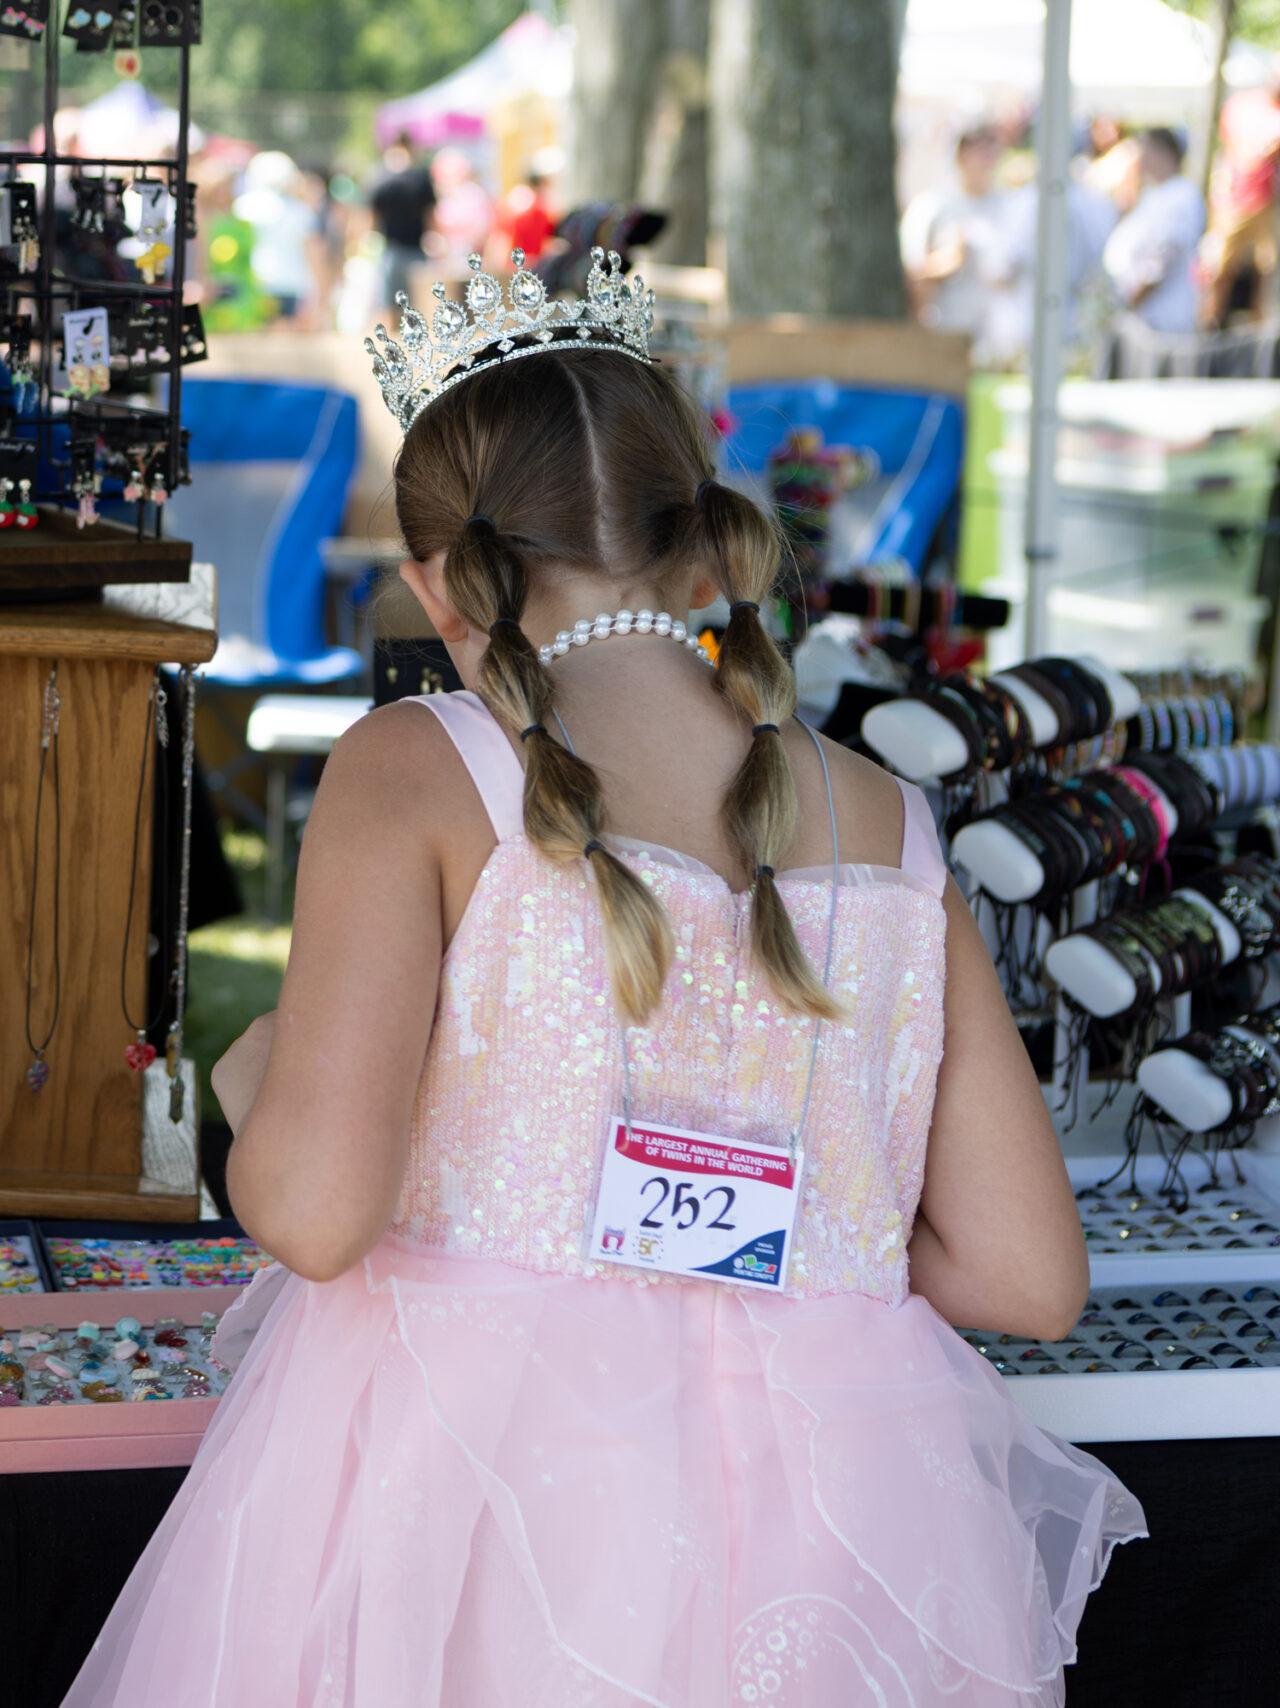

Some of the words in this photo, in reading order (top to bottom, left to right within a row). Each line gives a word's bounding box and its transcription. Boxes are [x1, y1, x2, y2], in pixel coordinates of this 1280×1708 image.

[626, 1133, 644, 1144] THE
[646, 1136, 688, 1151] LARGEST
[690, 1144, 730, 1160] ANNUAL
[732, 1153, 787, 1171] GATHERING
[646, 1146, 659, 1155] OF
[661, 1149, 692, 1163] TWINS
[694, 1155, 705, 1166] IN
[707, 1158, 726, 1169] THE
[727, 1162, 763, 1176] WORLD
[640, 1176, 736, 1231] 252
